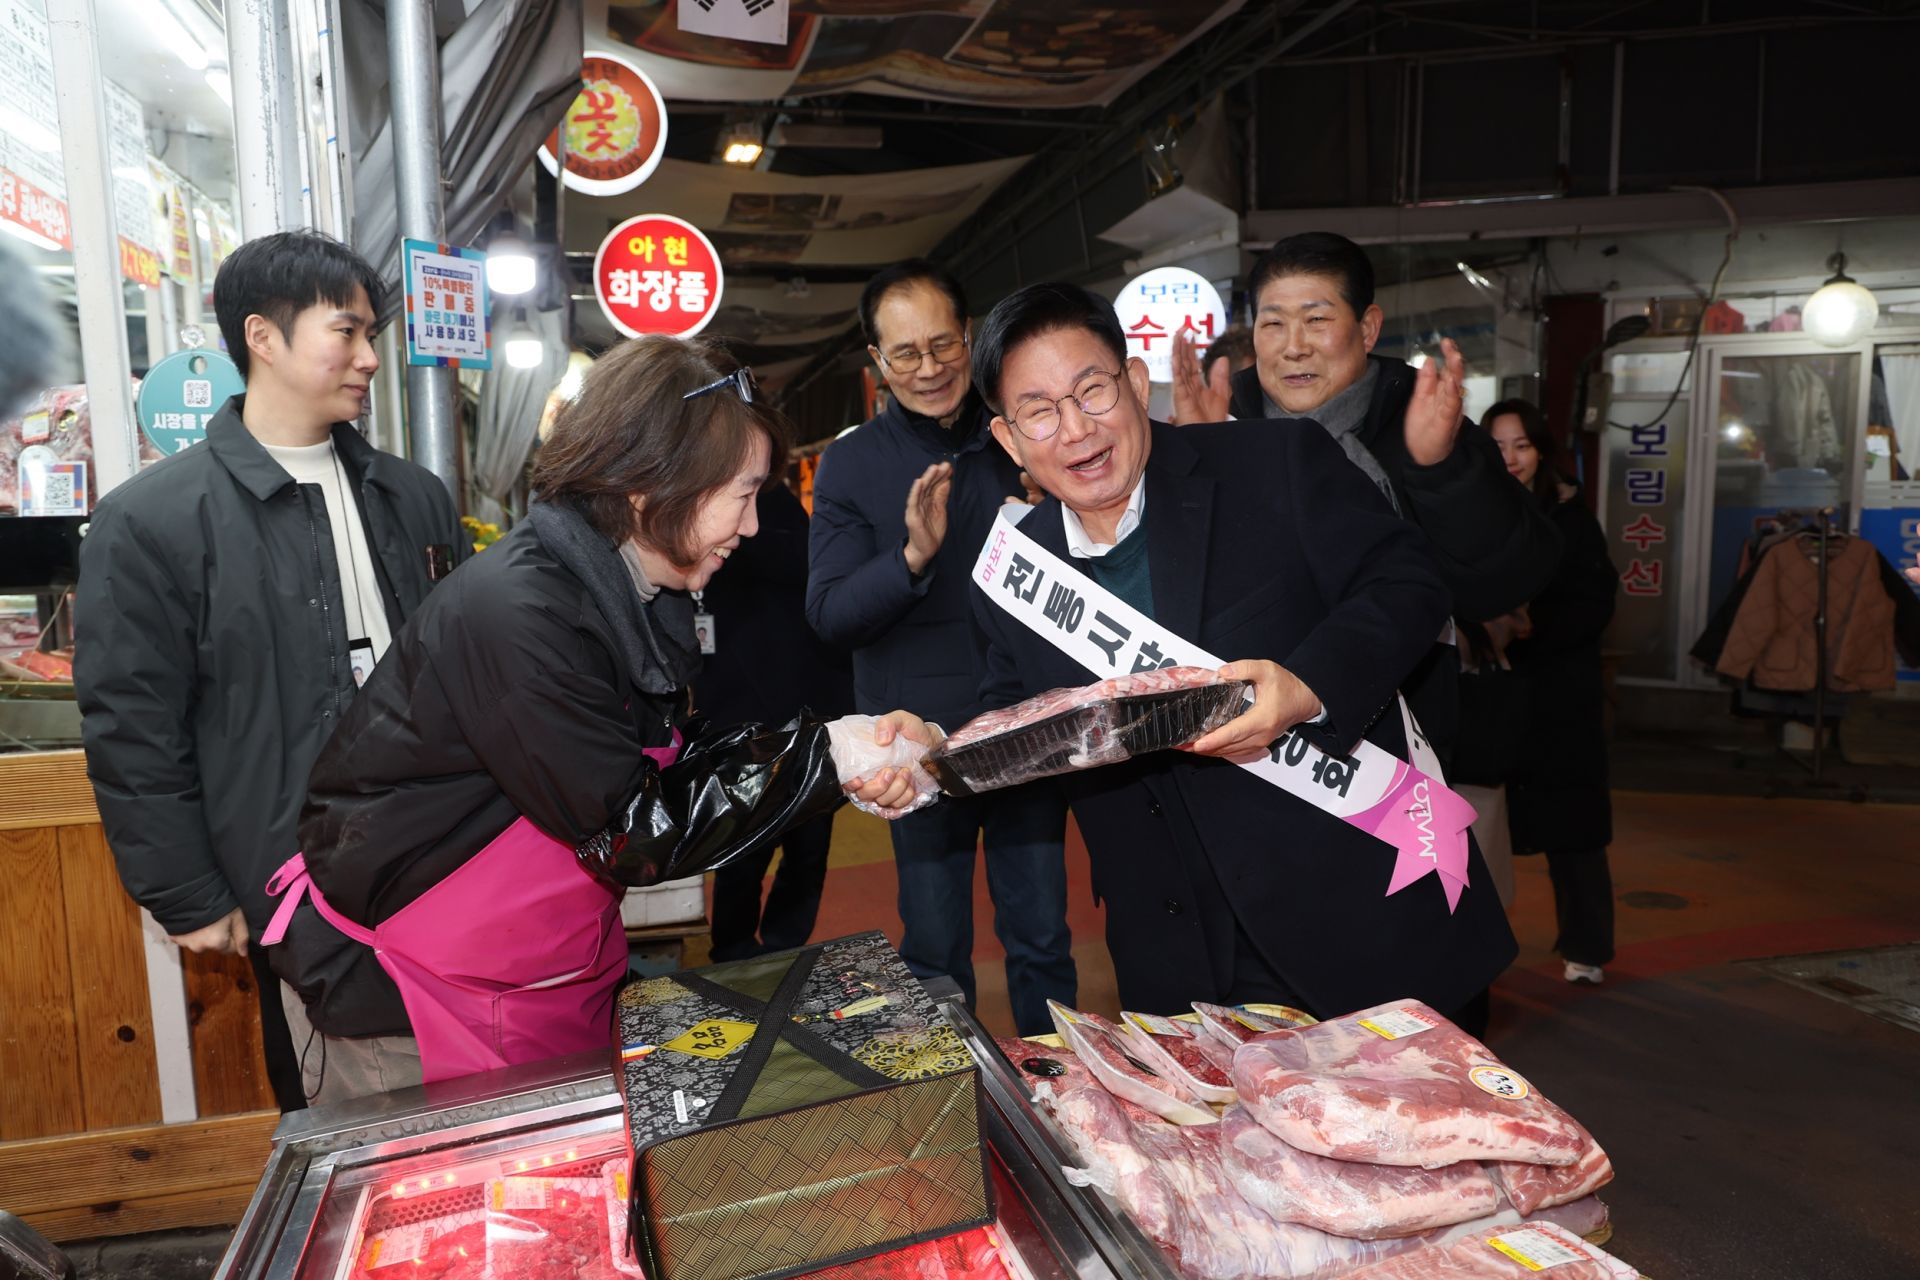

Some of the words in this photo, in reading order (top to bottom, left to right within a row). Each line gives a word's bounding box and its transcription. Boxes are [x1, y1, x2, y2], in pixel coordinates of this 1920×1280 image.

[573, 88, 619, 153] 꽃
[628, 235, 688, 266] 아현
[607, 268, 710, 313] 화장품
[1138, 282, 1199, 304] 보림
[1126, 312, 1214, 351] 수선
[152, 412, 197, 430] 시장을
[982, 529, 1007, 582] 마포구
[1409, 778, 1437, 864] MAPO
